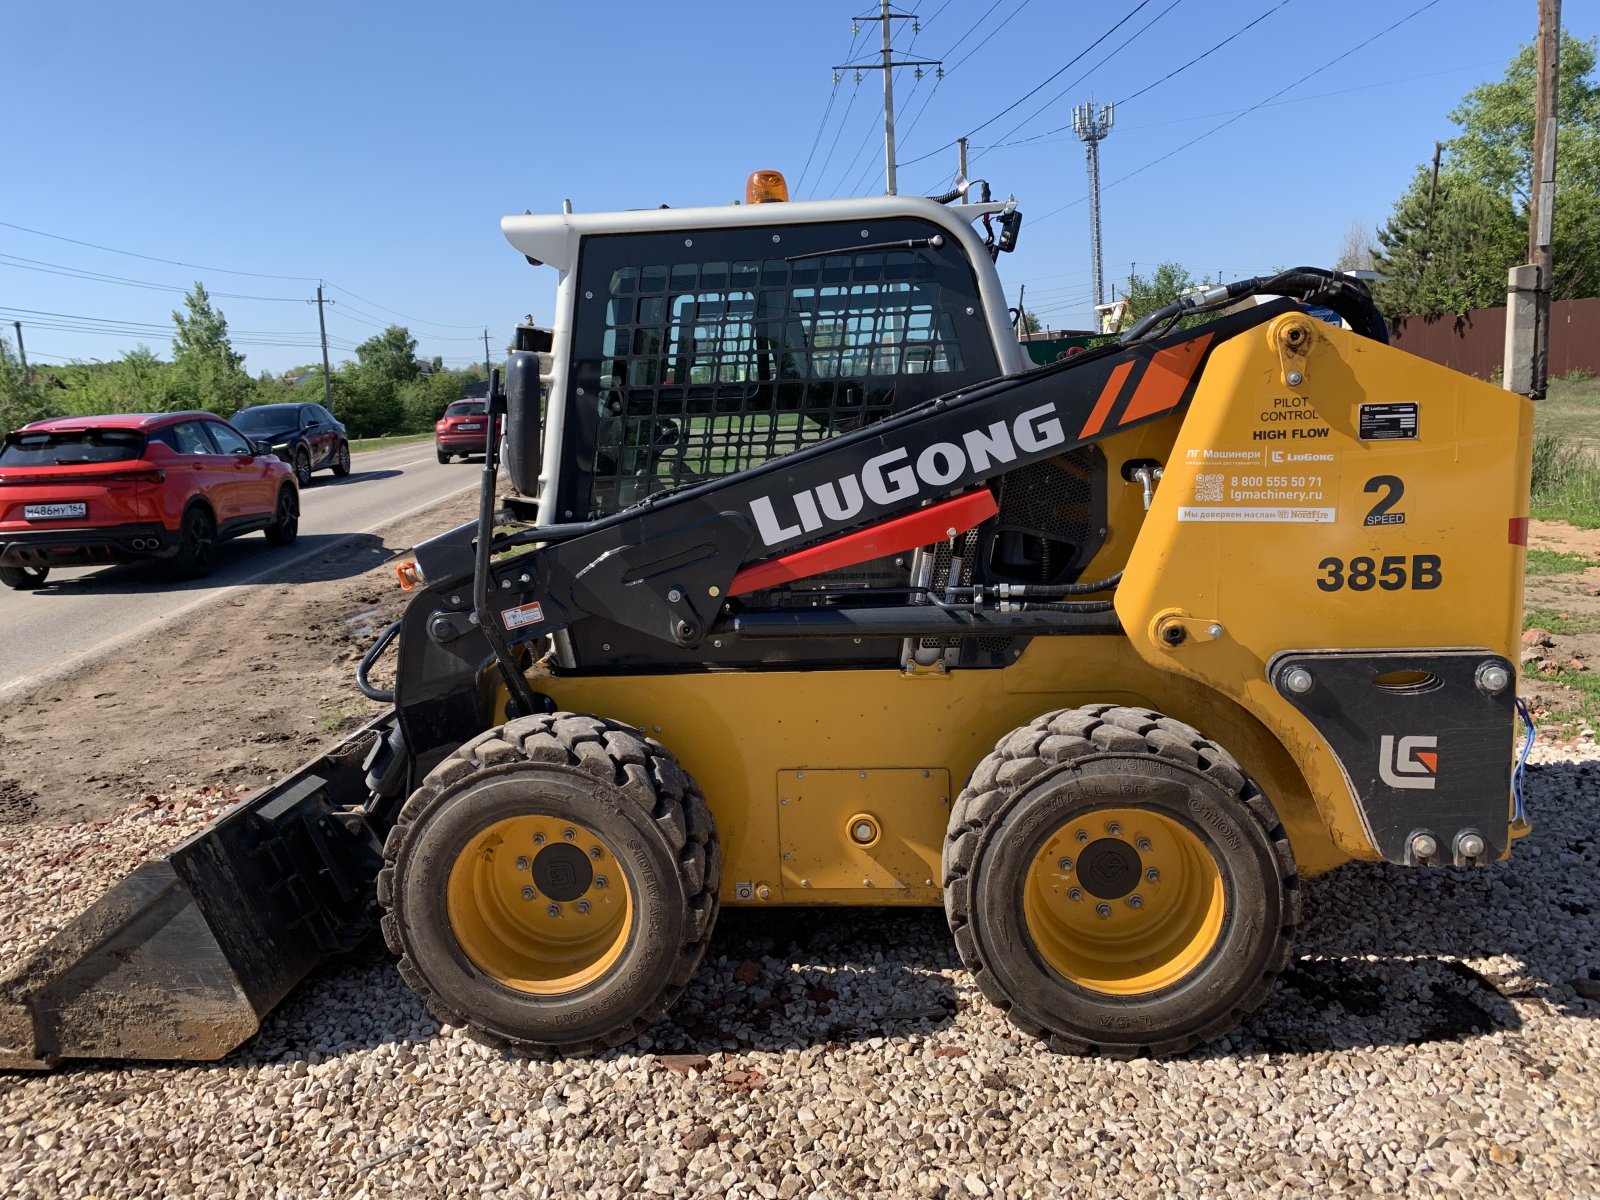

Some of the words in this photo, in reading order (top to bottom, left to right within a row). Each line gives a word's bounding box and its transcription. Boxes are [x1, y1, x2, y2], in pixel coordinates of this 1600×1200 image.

[1274, 397, 1309, 408] PILOT
[1261, 410, 1319, 421] CONTROL
[1253, 430, 1287, 440] HIGH
[1292, 428, 1329, 438] FLOW
[1186, 449, 1201, 459] ЛГ
[1203, 449, 1261, 460] Машинери
[1231, 476, 1238, 487] 8
[1241, 476, 1263, 487] 800
[1266, 476, 1288, 487] 555
[1291, 476, 1305, 487] 50
[1309, 476, 1322, 487] 71
[1230, 489, 1323, 502] lgmachinery.ru
[1363, 475, 1405, 526] 2
[1367, 514, 1404, 525] SPEED
[1316, 554, 1443, 592] 385B
